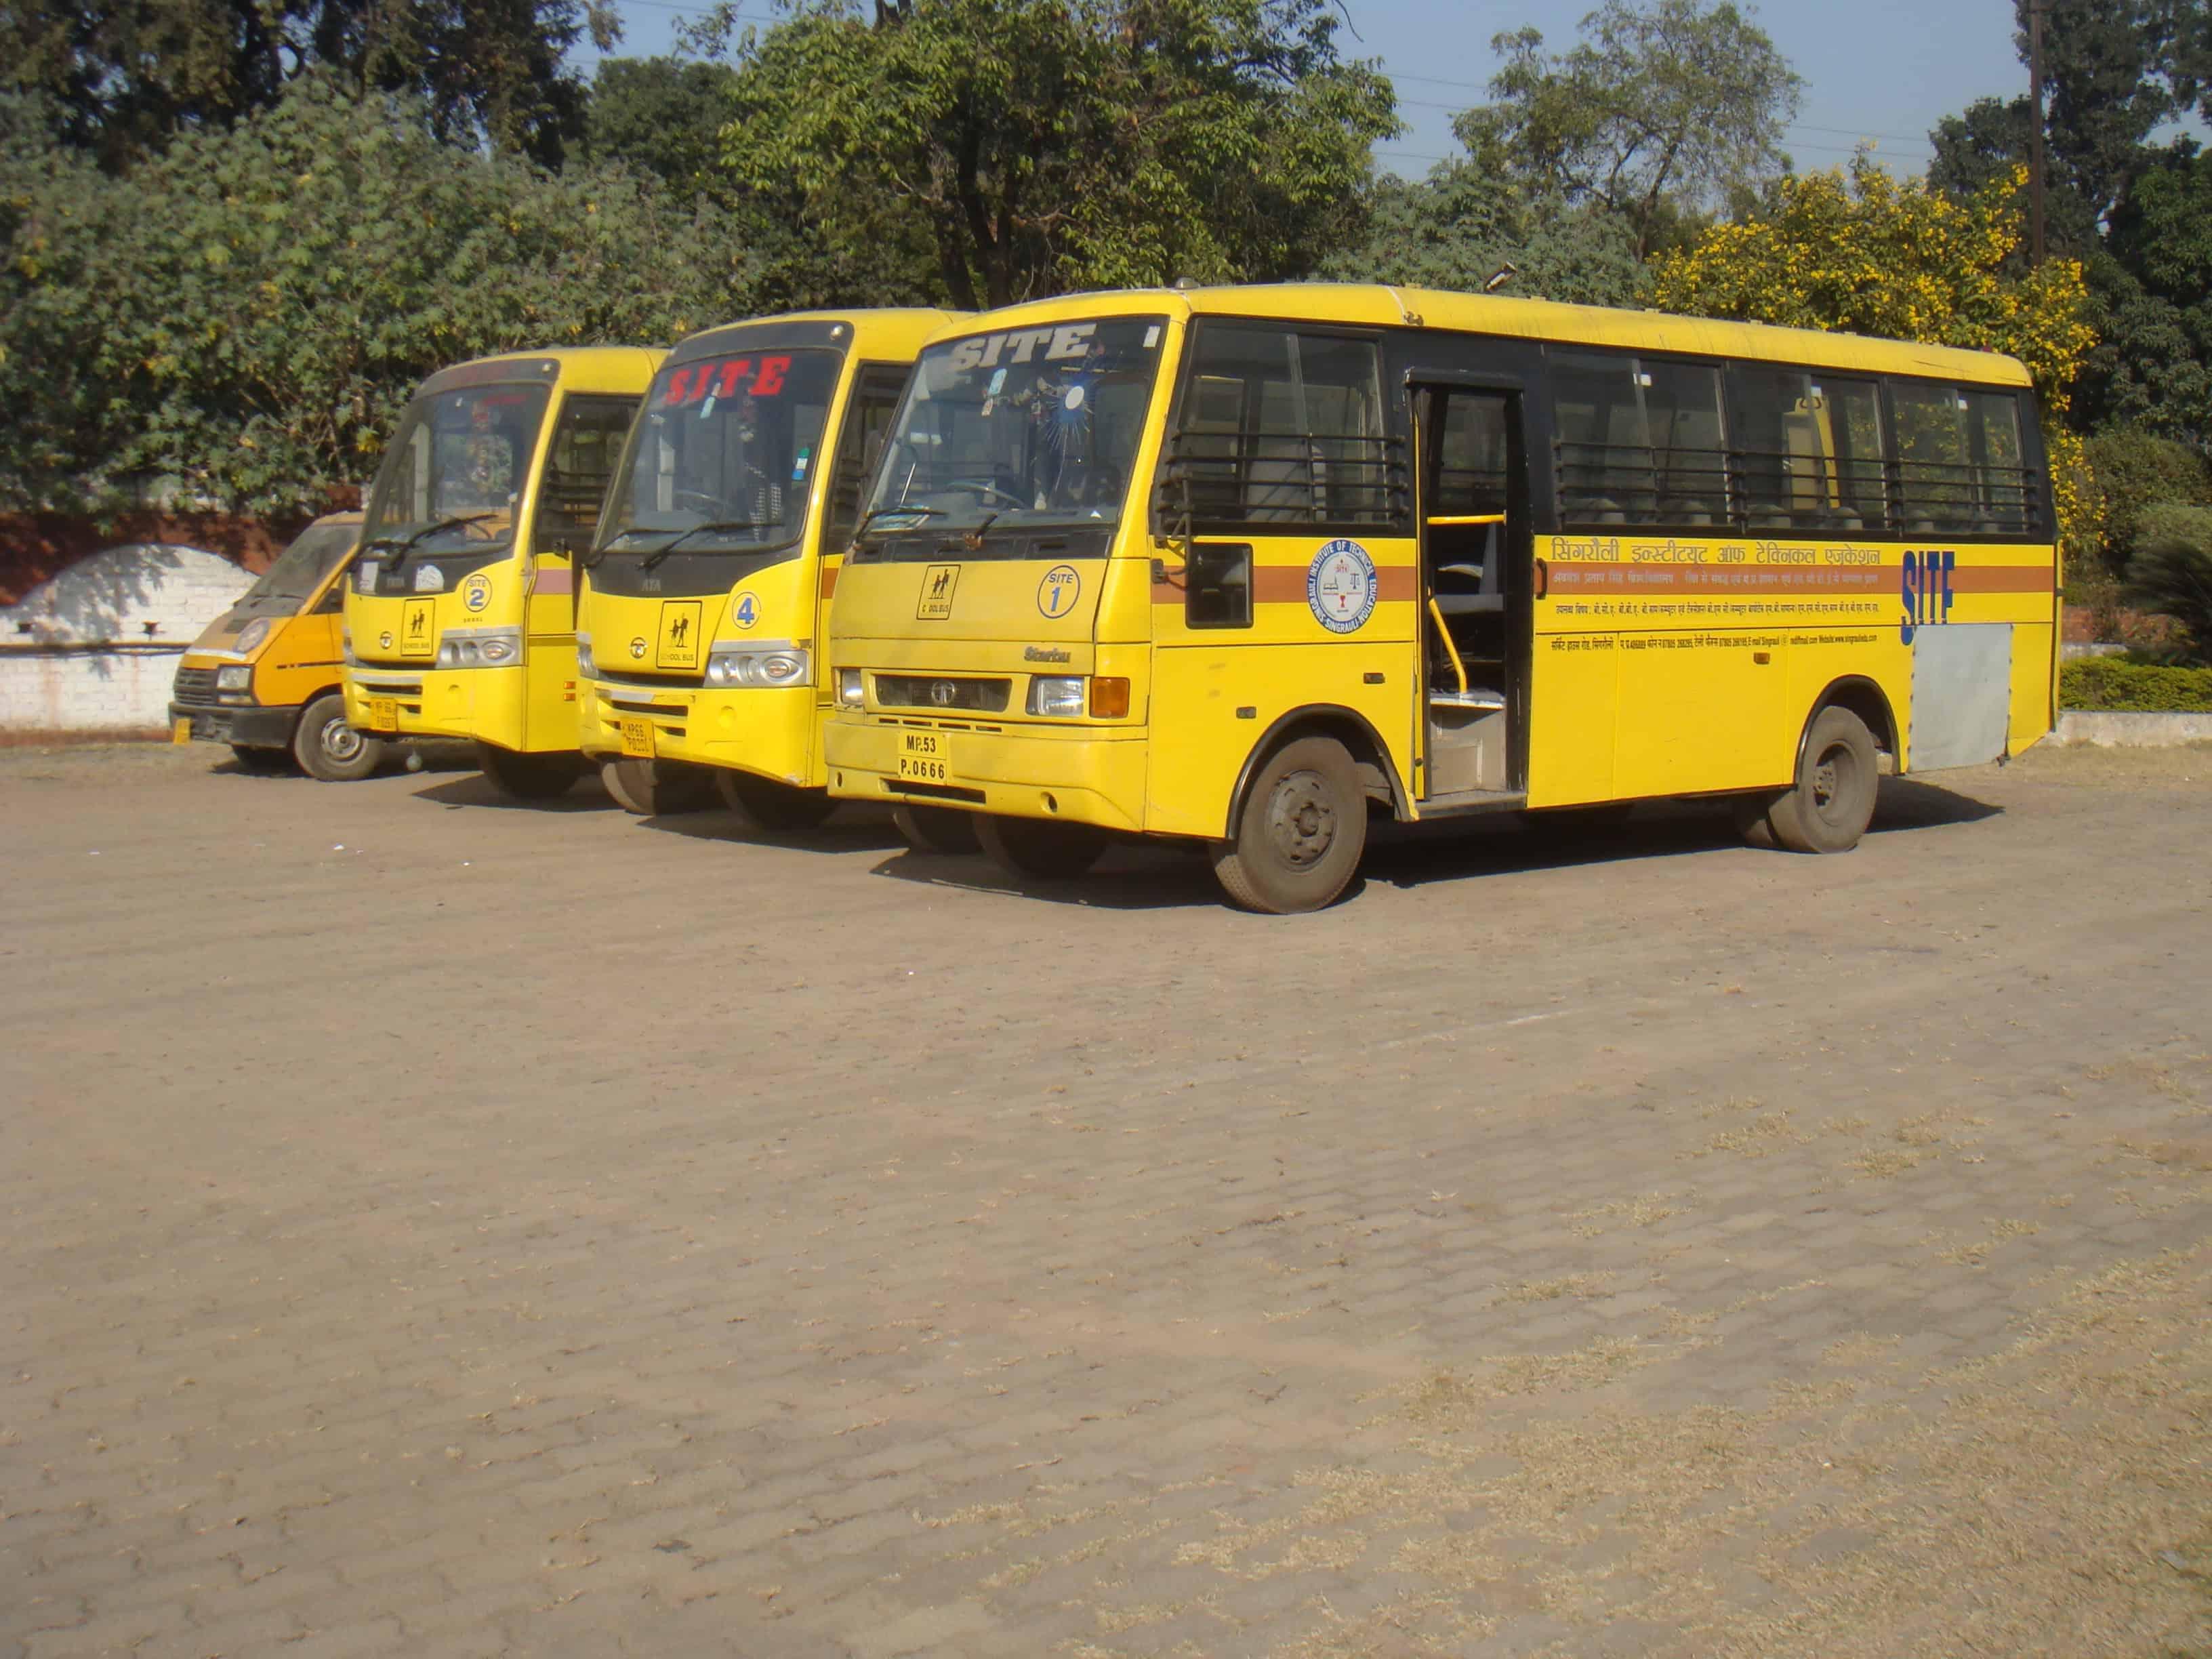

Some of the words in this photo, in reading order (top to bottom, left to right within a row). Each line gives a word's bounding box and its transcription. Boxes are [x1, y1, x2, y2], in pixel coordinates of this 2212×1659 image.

[949, 323, 1097, 371] SITE
[664, 355, 792, 405] SITE
[1309, 543, 1334, 576] INSTITUTE
[1336, 541, 1346, 552] OF
[1349, 541, 1374, 576] TECHNICAL
[1551, 536, 1620, 561] सिंगरौली
[1048, 573, 1073, 583] SITE
[470, 588, 485, 607] 2
[737, 597, 762, 624] 4
[1051, 586, 1061, 612] 1
[1359, 579, 1377, 624] EDUCATION
[1901, 550, 1955, 645] SITE
[907, 735, 937, 753] MP.53
[901, 758, 945, 779] P.0666
